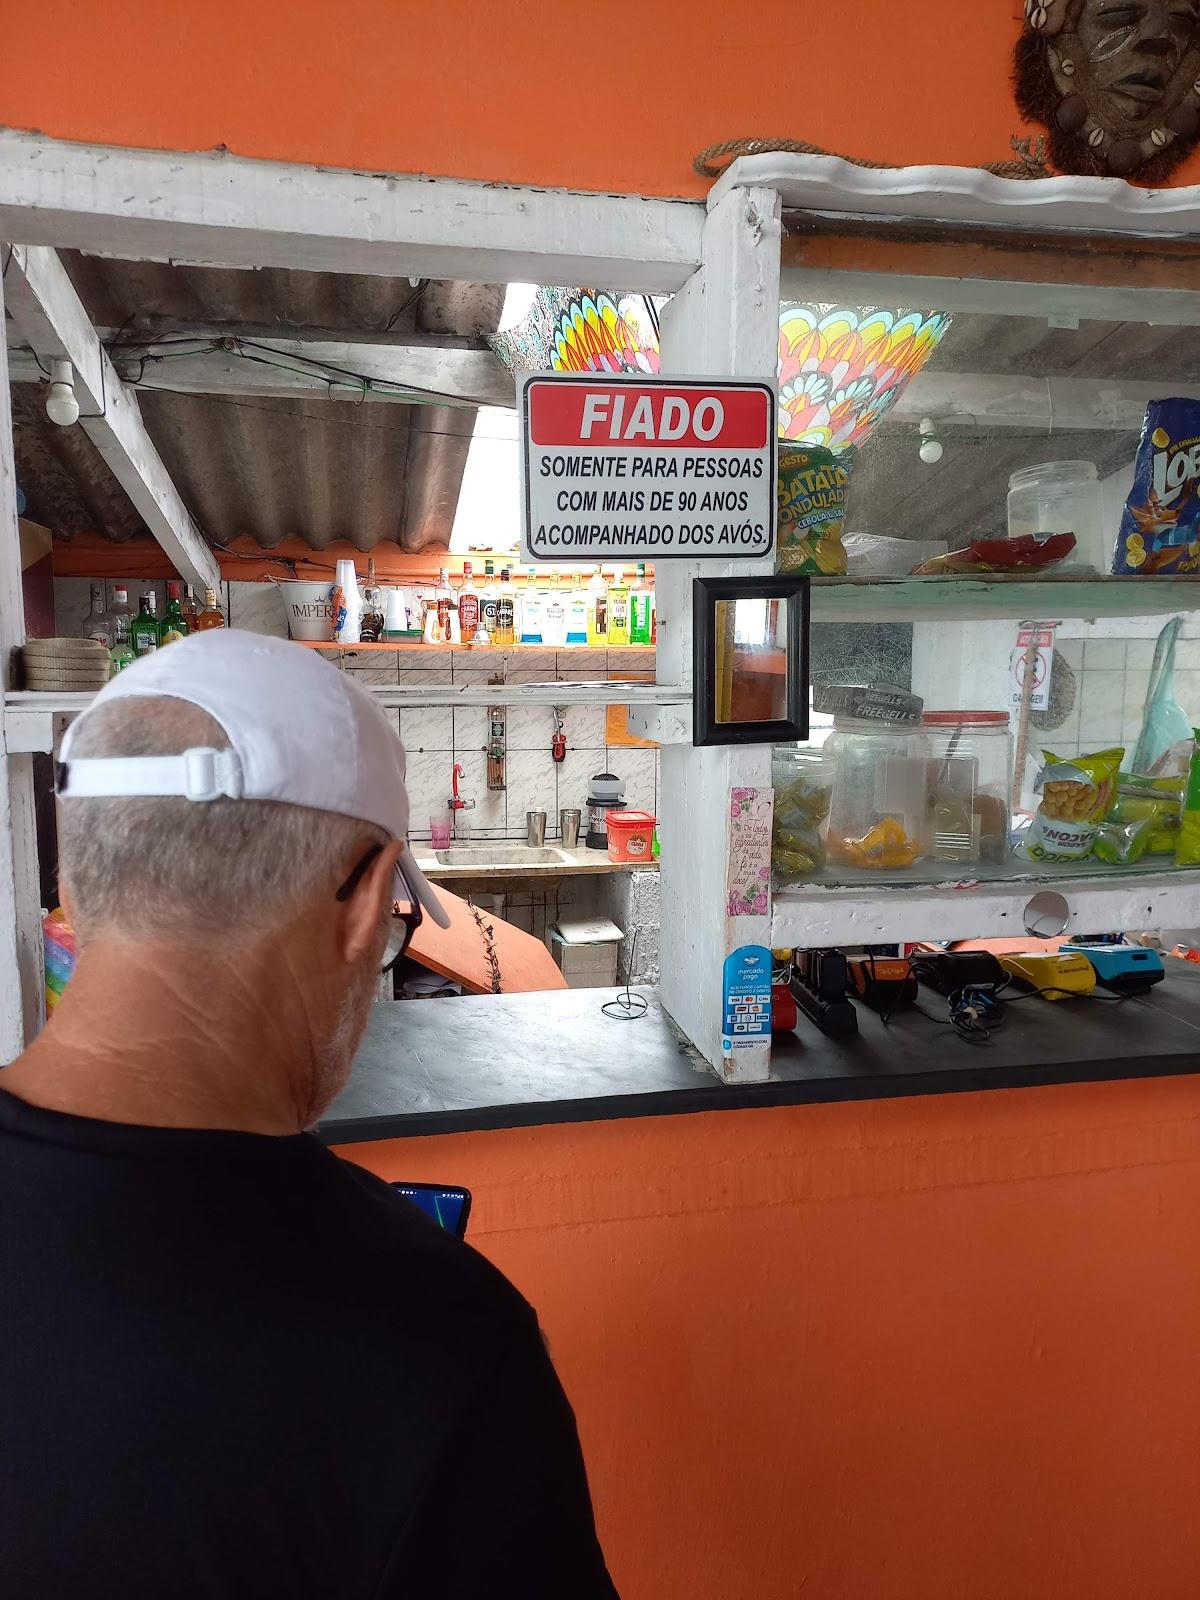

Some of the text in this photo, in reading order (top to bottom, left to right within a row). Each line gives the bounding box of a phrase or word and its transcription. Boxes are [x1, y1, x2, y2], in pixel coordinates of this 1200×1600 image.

[580, 394, 725, 441] FIADO
[540, 456, 763, 478] SOMENTE PARA PESSOAS
[778, 465, 848, 507] BATATA
[556, 490, 749, 511] COM MAIS DE 90 ANOS
[779, 490, 848, 523] ONDULAD
[535, 519, 767, 545] ACOMPANHADO DOS AVÓS.
[798, 512, 828, 529] CEBOLA
[487, 607, 497, 616] 51
